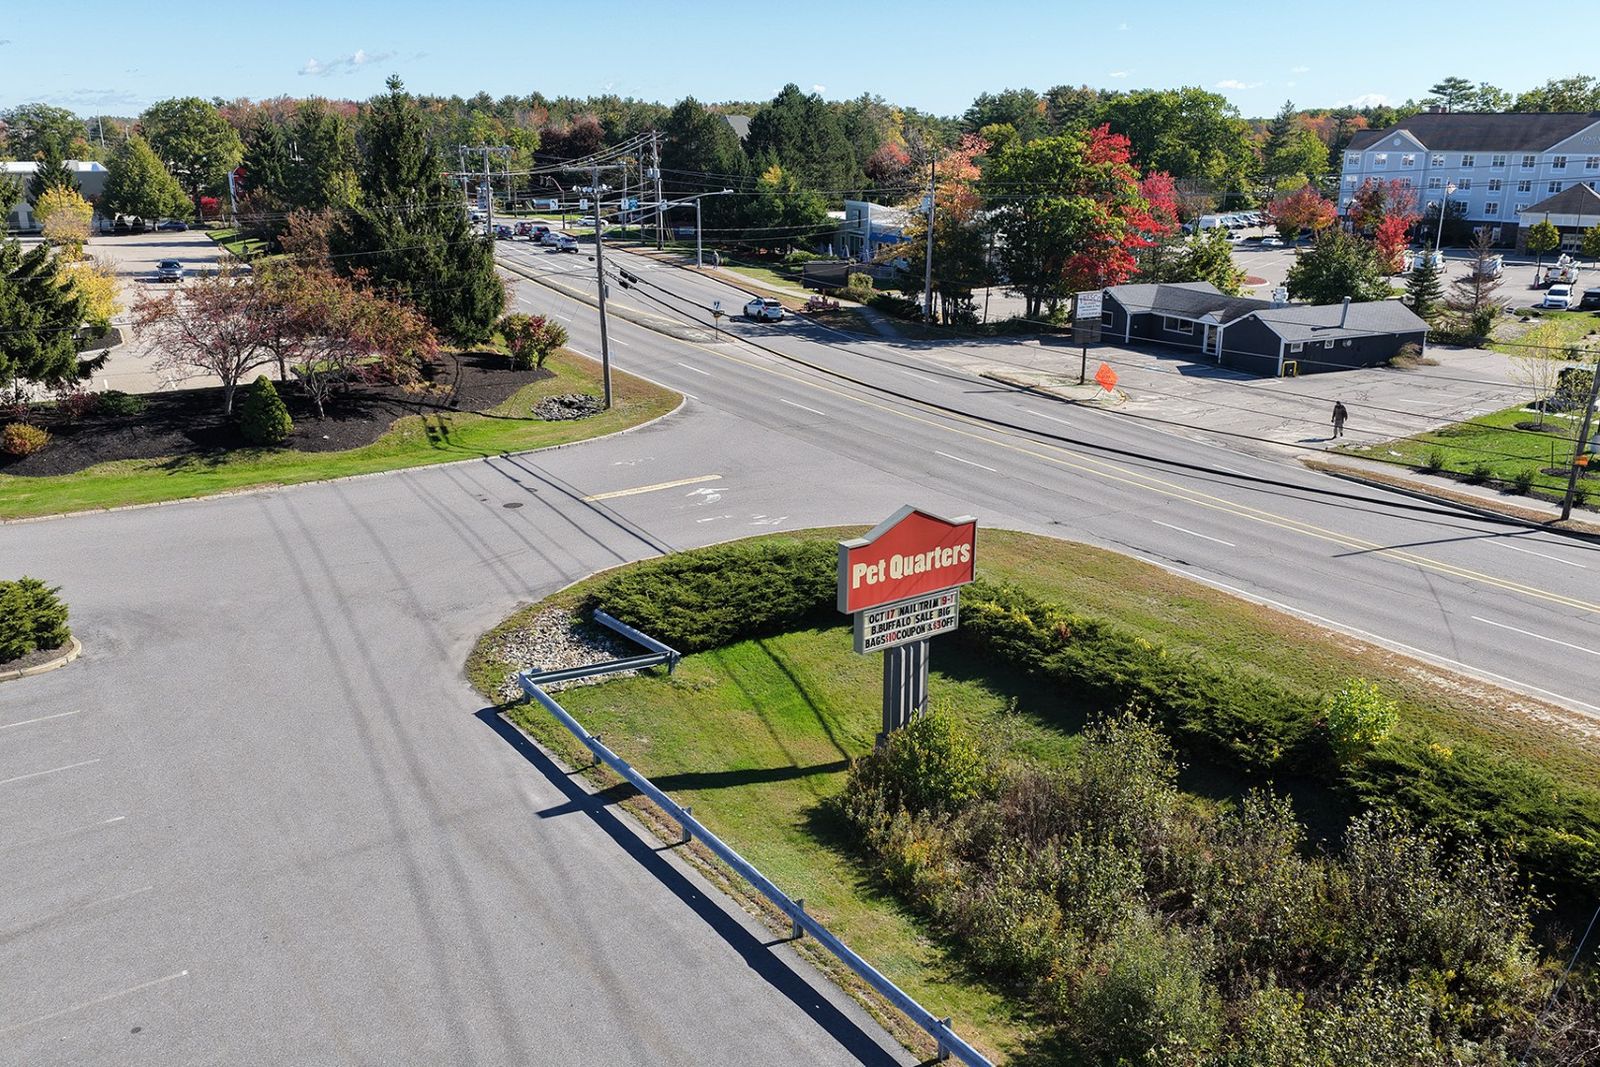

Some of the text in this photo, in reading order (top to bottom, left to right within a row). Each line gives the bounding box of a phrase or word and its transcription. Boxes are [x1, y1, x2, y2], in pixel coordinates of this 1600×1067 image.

[852, 543, 971, 589] Pet Quarters
[868, 612, 884, 624] OCT
[886, 609, 895, 620] 17
[899, 604, 917, 616] NAIL
[919, 598, 939, 610] TRIM
[915, 610, 934, 624] SALE
[938, 606, 951, 618] BIG
